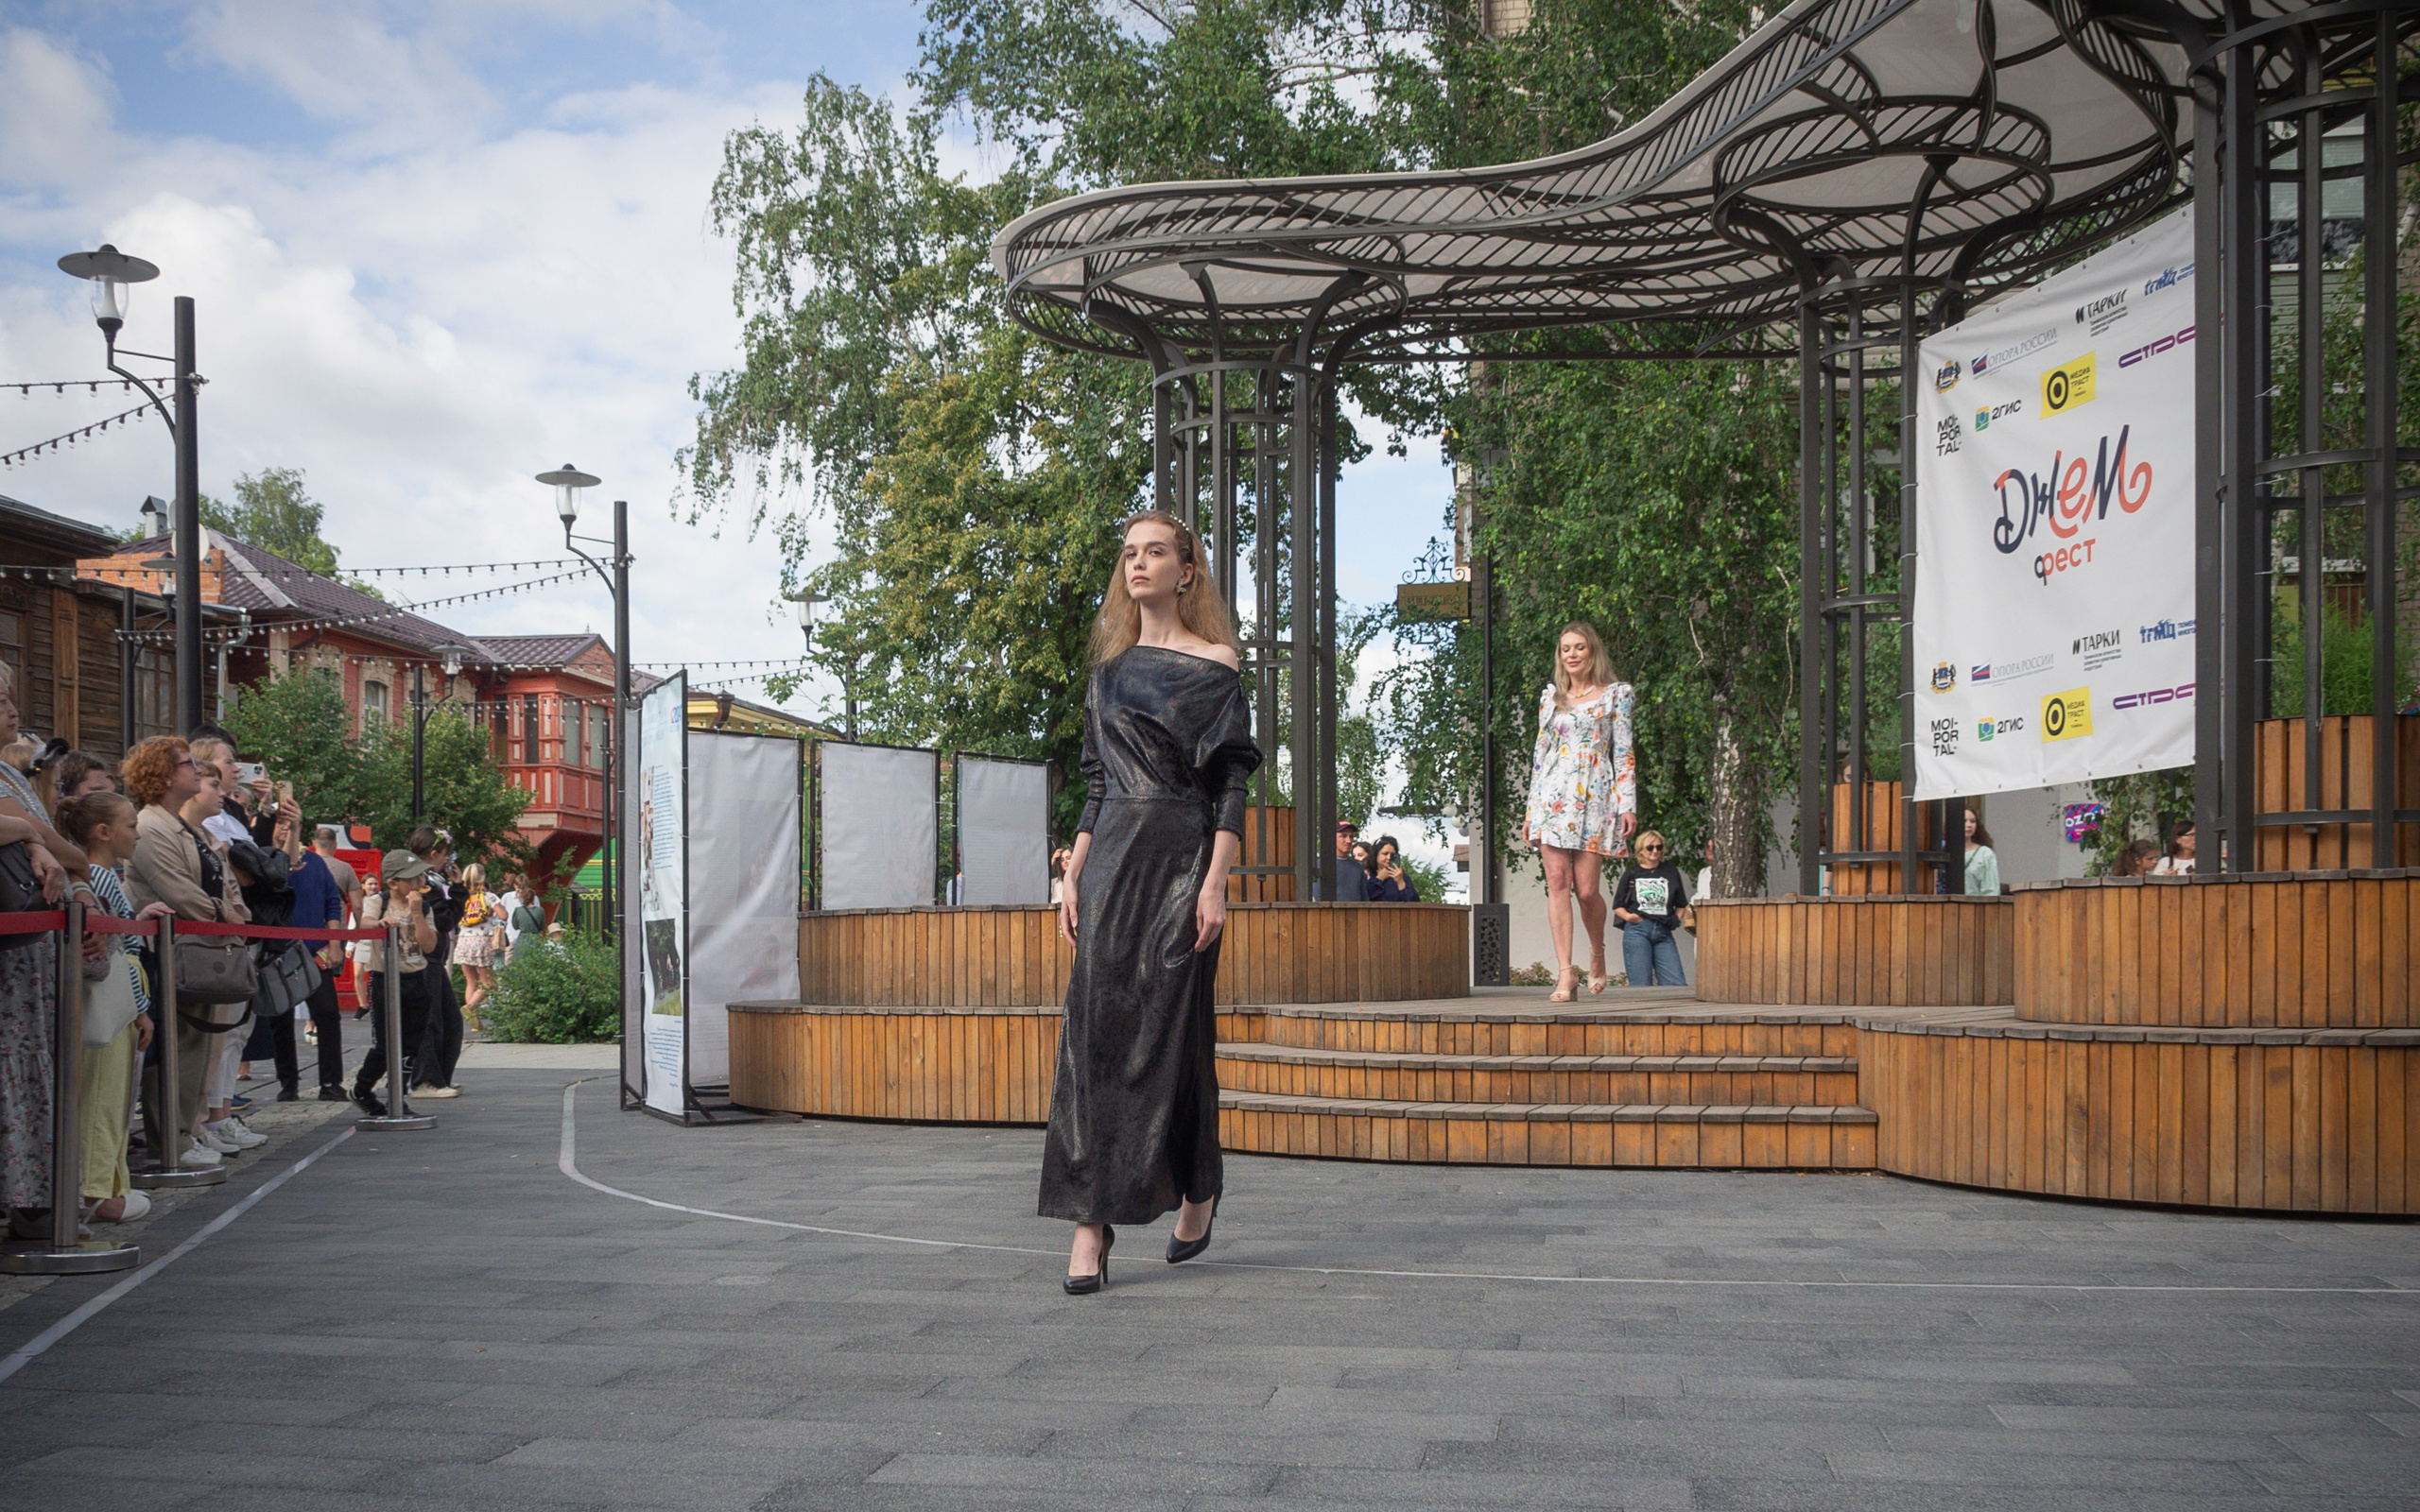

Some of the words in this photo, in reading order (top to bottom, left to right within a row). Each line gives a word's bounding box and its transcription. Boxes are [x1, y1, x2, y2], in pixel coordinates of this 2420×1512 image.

[2086, 288, 2128, 318] ТАРКИ
[1988, 346, 2019, 368] ОПОРА
[2020, 327, 2058, 353] РОССИИ
[1992, 400, 2022, 421] 2ГИС
[1939, 426, 1962, 444] POR
[2082, 628, 2120, 652] ТАРКИ
[1992, 660, 2021, 679] ОПОРА
[2021, 653, 2054, 672] РОССИИ
[1997, 717, 2024, 733] 2ГИС
[1933, 730, 1959, 745] POR
